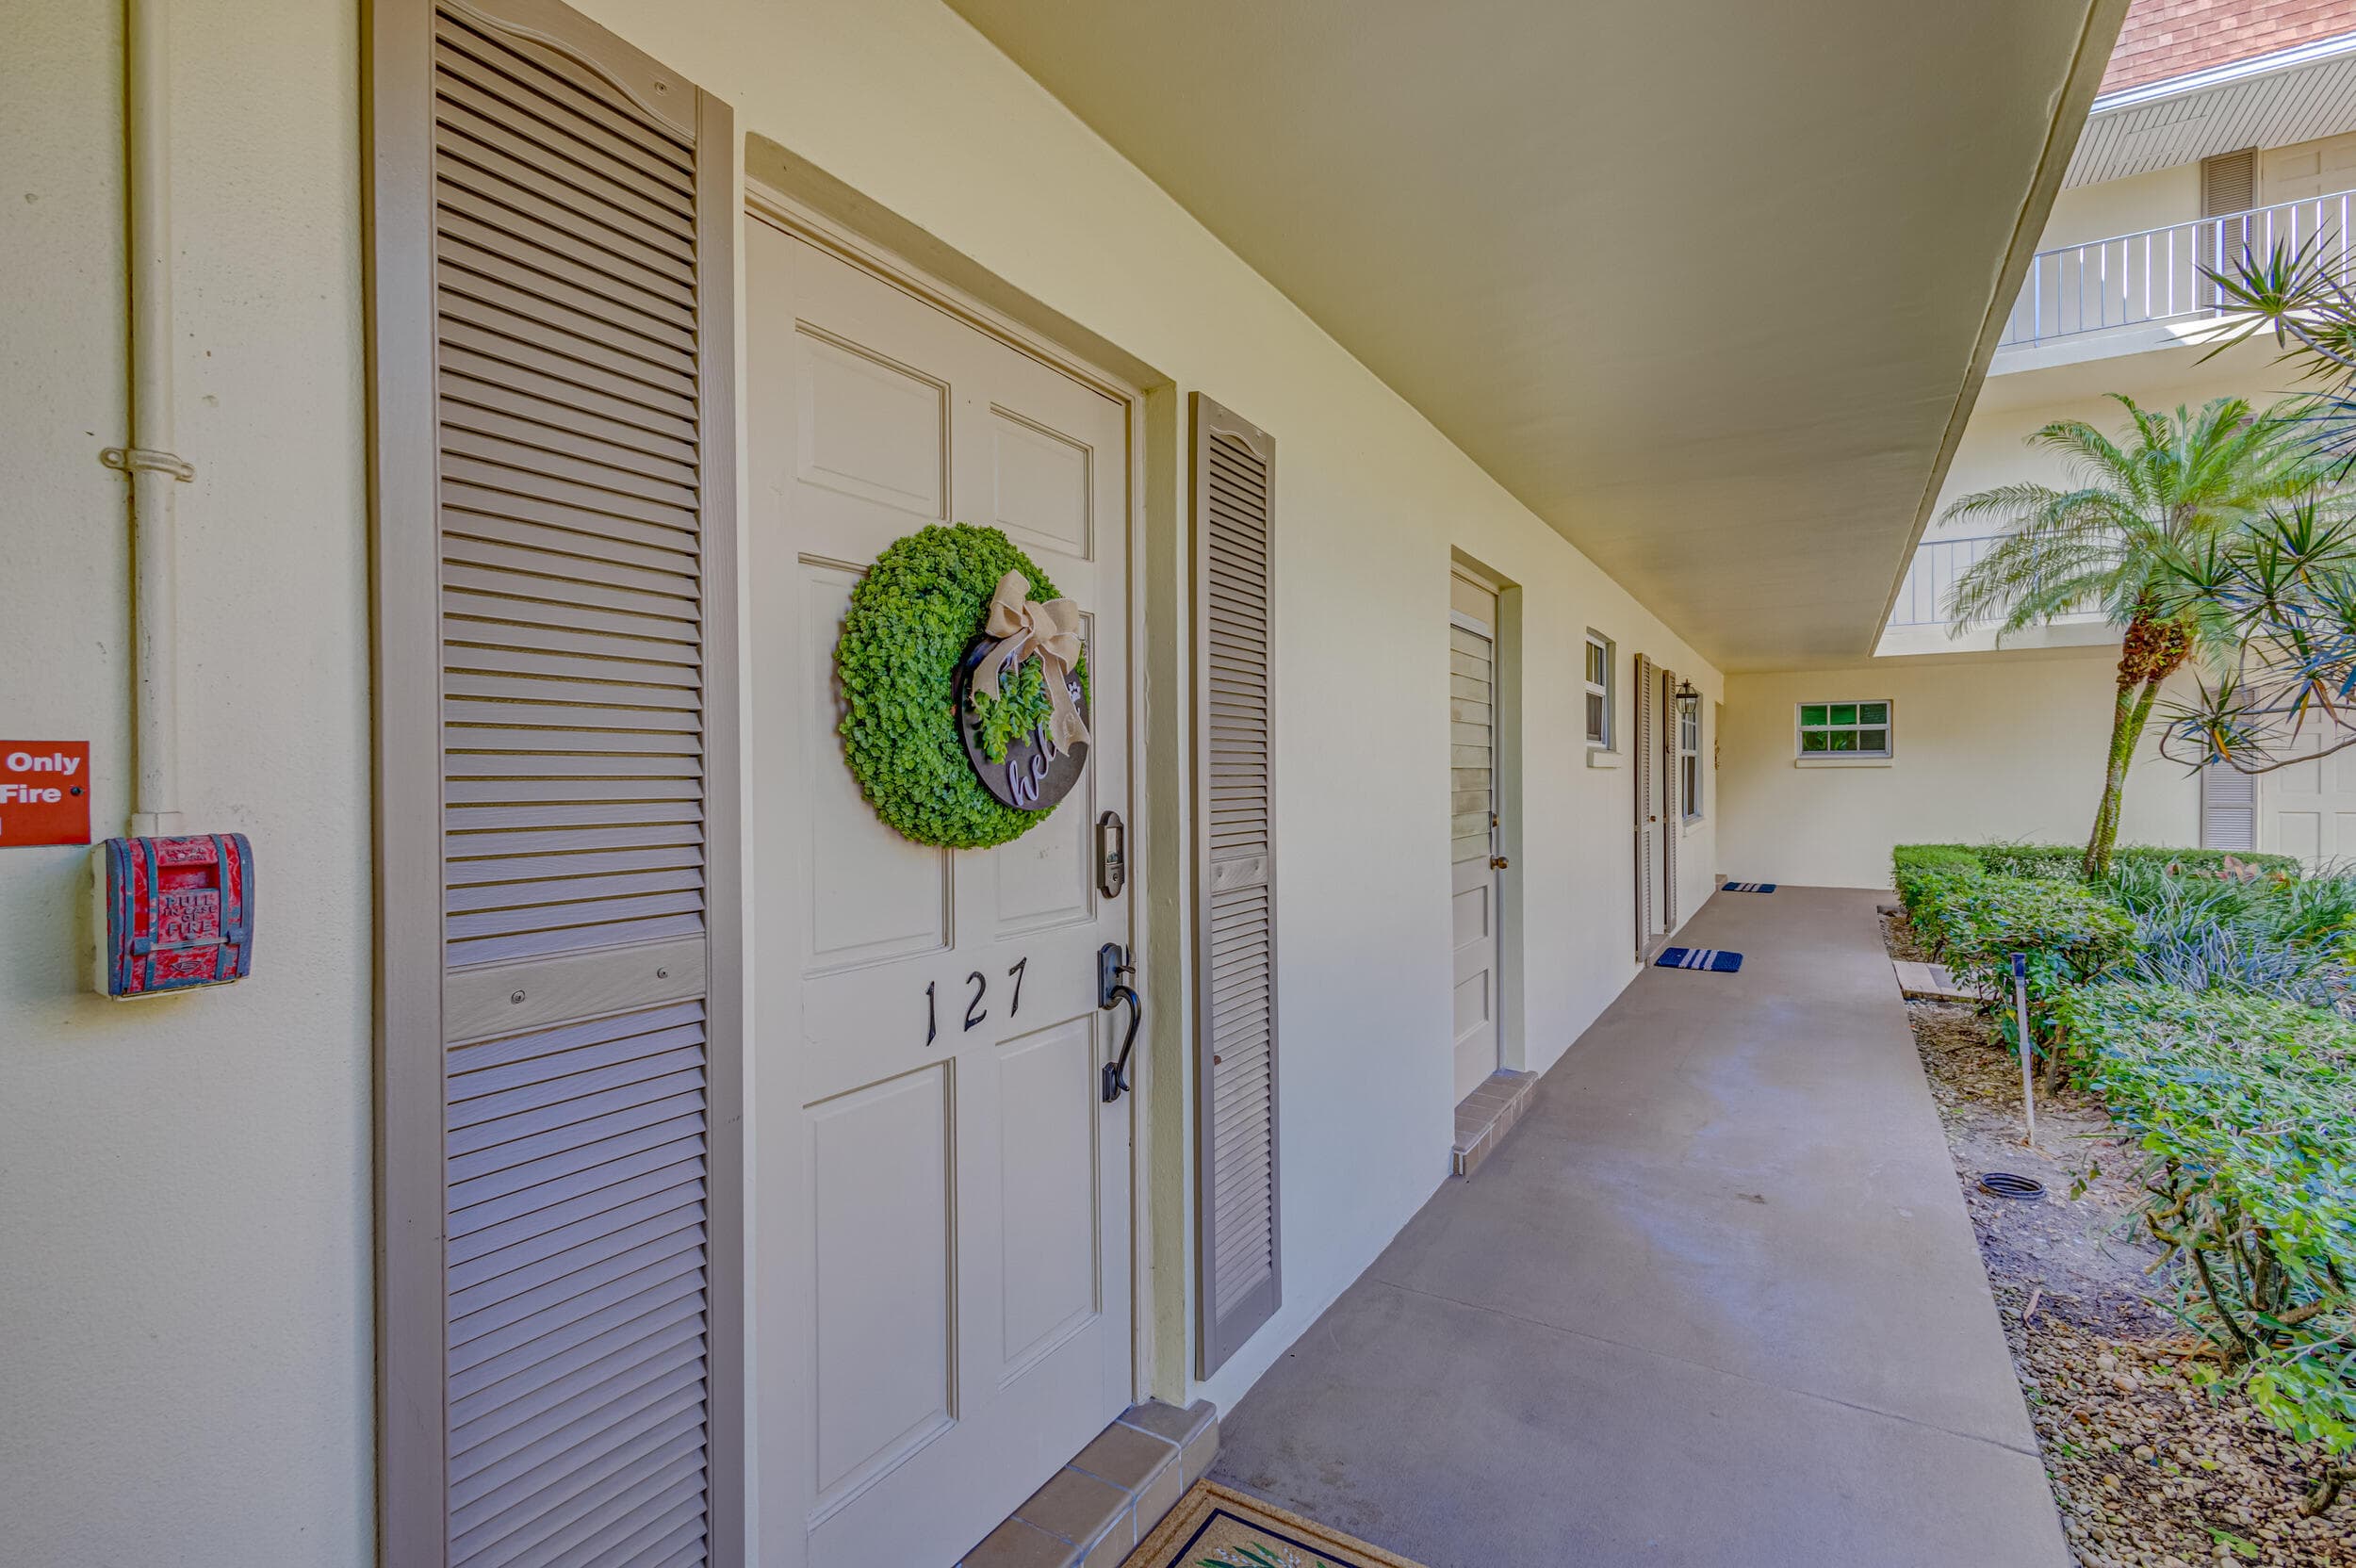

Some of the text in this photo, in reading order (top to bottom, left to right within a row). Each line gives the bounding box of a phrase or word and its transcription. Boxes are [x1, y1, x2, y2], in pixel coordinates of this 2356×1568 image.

[7, 752, 81, 776] Only
[1008, 719, 1056, 807] hel
[0, 783, 62, 804] Fire
[164, 894, 213, 908] PULL
[167, 920, 213, 936] FIRE
[925, 956, 1027, 1046] 127
